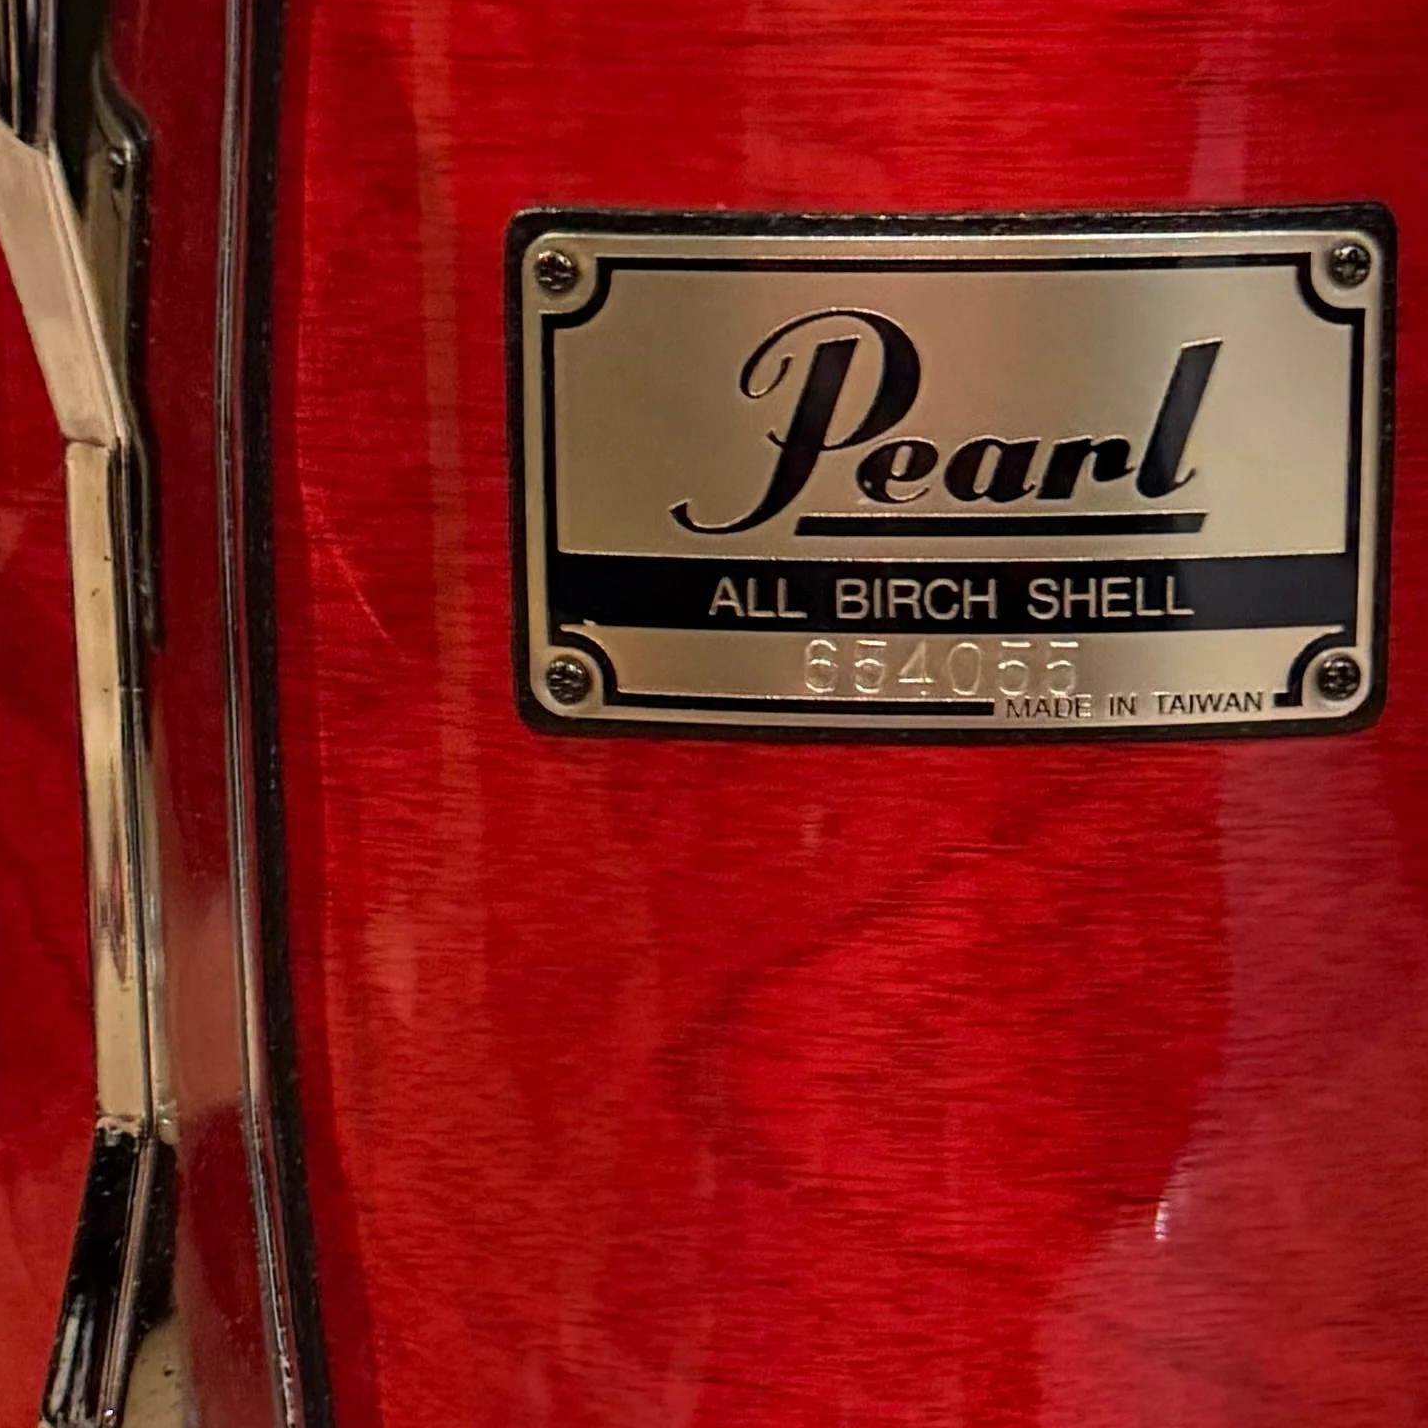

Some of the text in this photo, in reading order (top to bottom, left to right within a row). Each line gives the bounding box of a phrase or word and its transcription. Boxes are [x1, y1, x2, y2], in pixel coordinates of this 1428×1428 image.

[668, 307, 1224, 536] Pearl
[708, 576, 1195, 620] ALL BIRCH SHELL
[803, 638, 1081, 697] 654055
[1004, 690, 1265, 721] MADE IN TAIWAN
